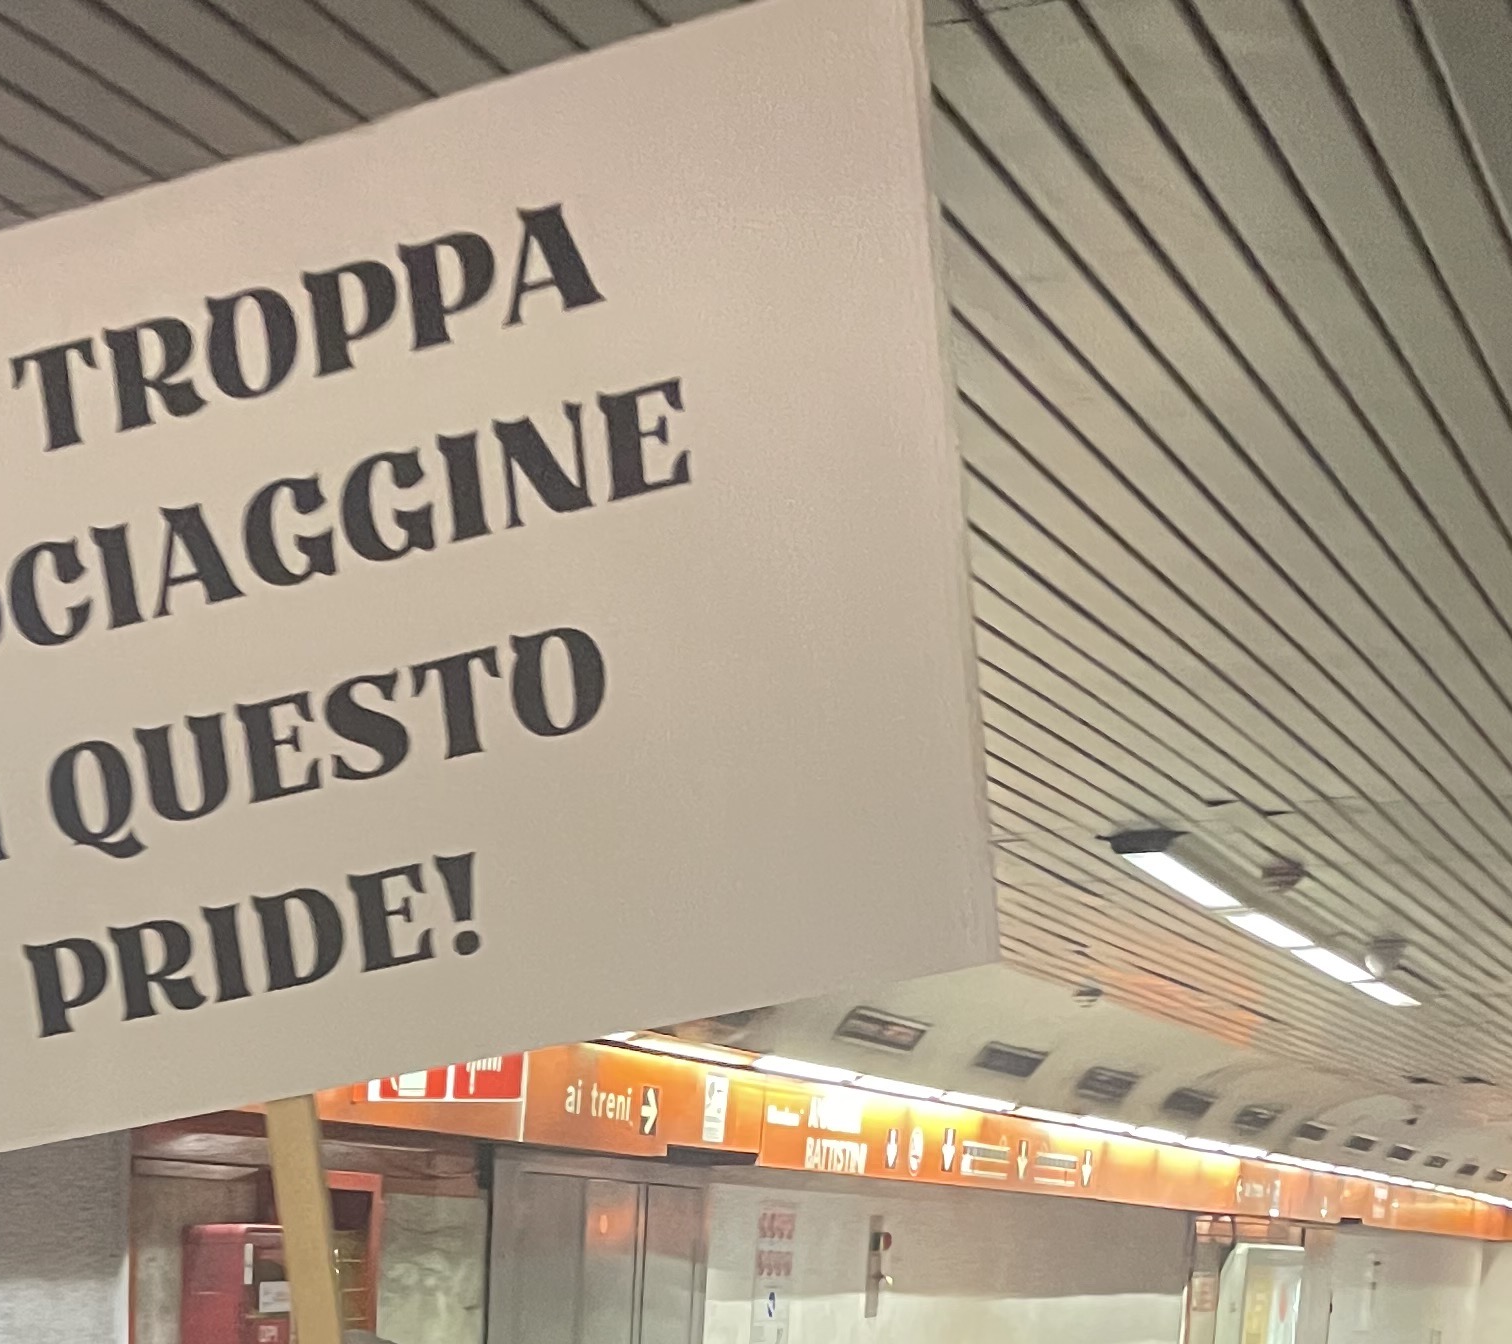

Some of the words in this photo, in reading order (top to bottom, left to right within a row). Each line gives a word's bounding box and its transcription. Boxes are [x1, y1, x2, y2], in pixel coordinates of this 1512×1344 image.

[10, 202, 605, 453] TROPPA
[48, 626, 607, 860] QUESTO
[22, 850, 479, 1039] PRIDE!
[565, 1079, 583, 1115] ai
[590, 1082, 633, 1122] treni
